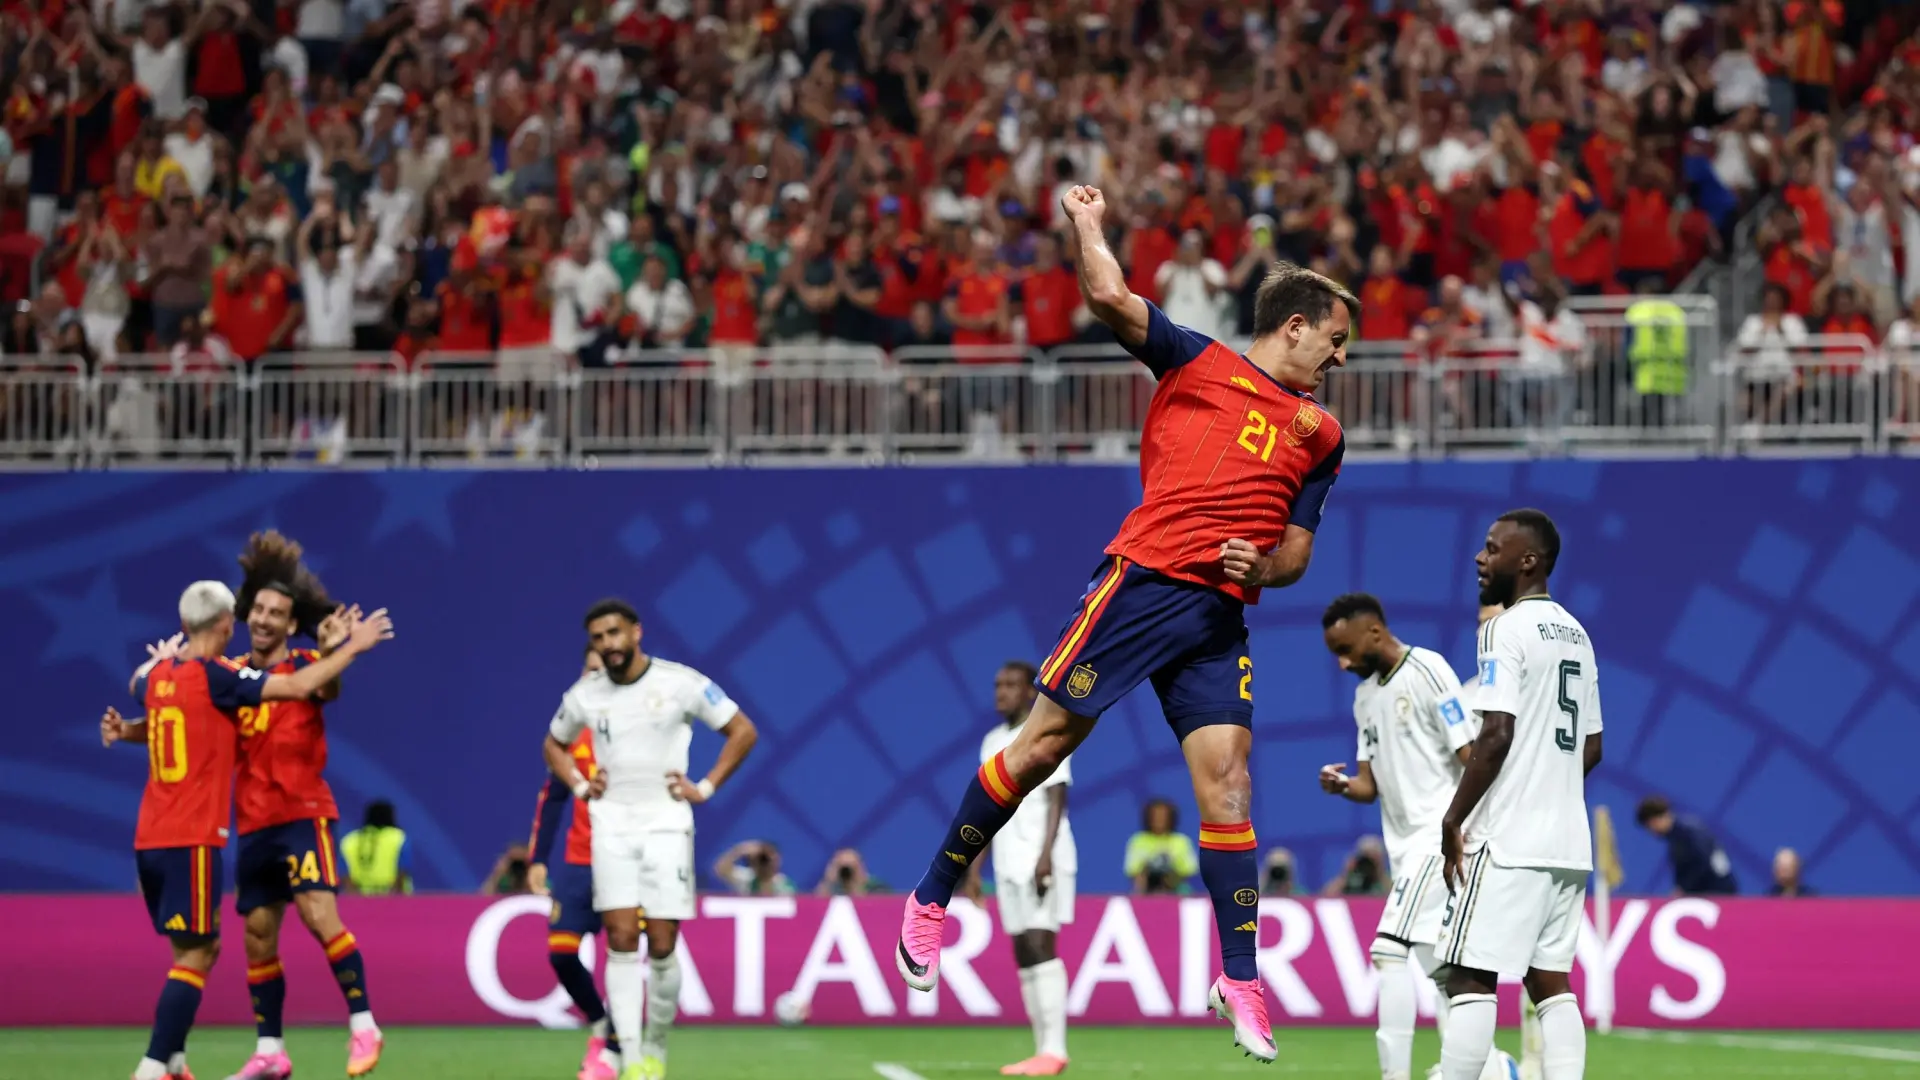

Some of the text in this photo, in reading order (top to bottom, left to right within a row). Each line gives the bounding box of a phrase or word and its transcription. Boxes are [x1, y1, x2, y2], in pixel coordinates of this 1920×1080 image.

[1236, 409, 1279, 463] 21
[1554, 658, 1584, 756] 5
[148, 705, 188, 783] 10
[286, 849, 321, 887] 24
[1394, 876, 1410, 907] 4
